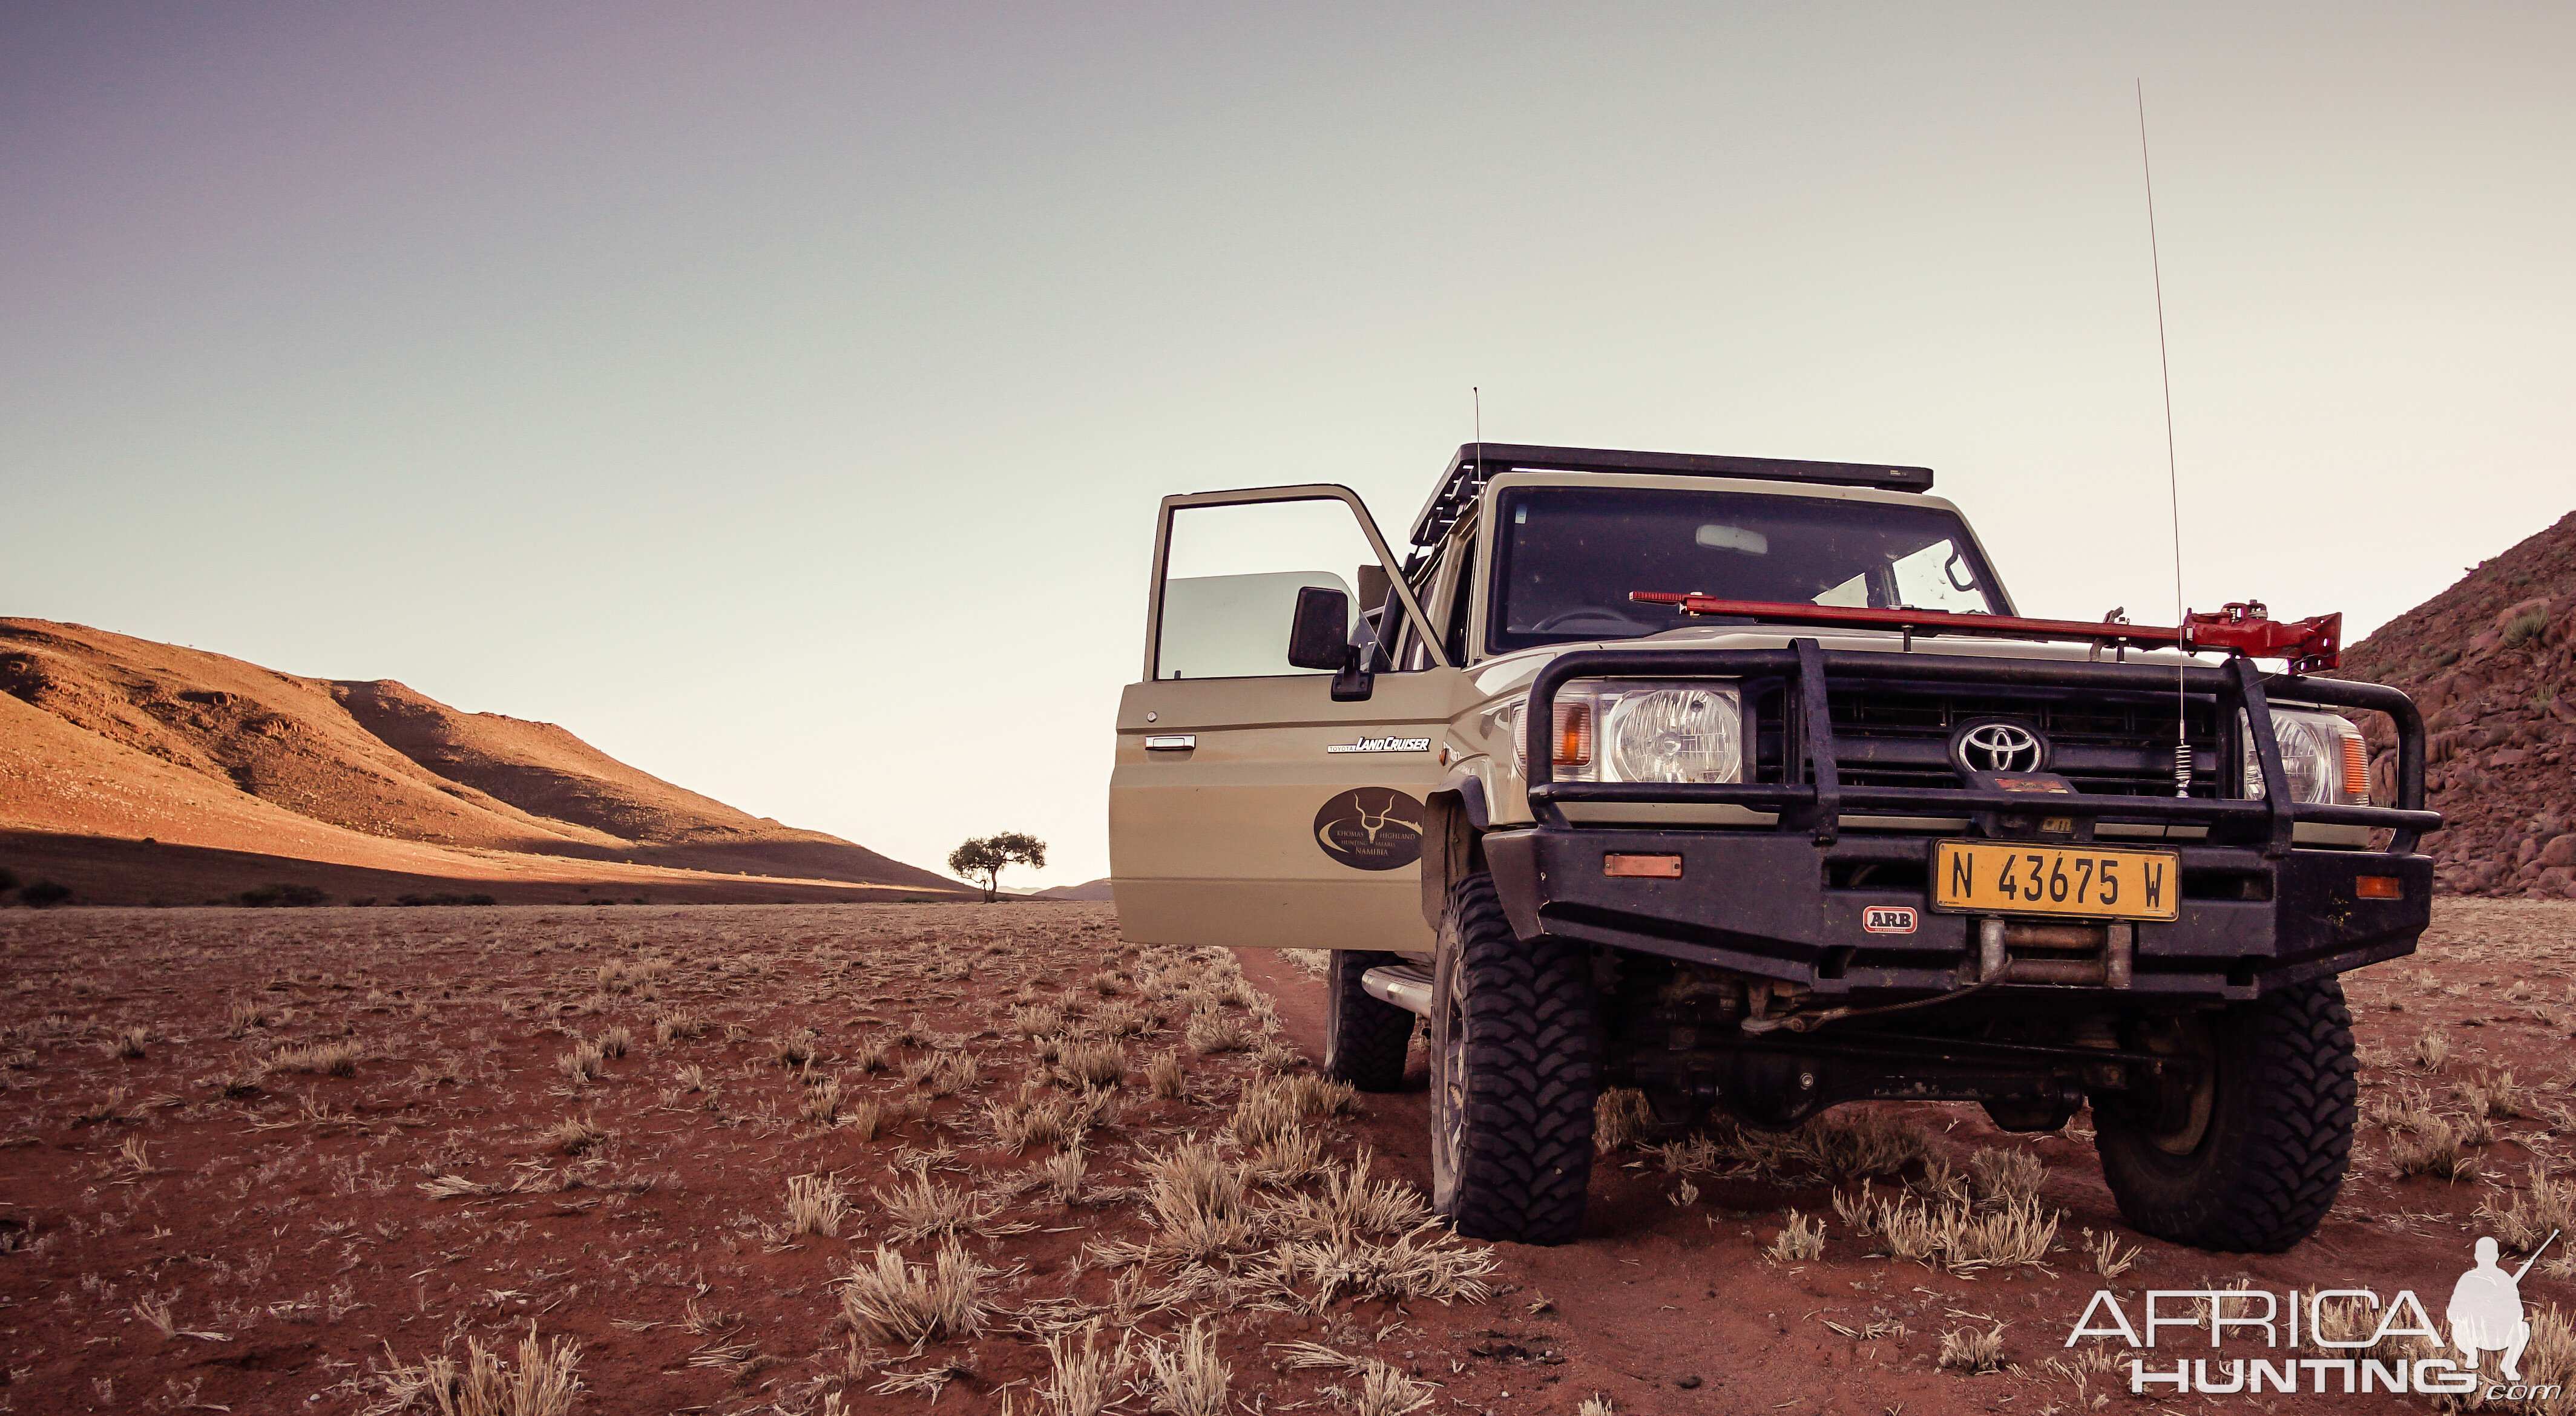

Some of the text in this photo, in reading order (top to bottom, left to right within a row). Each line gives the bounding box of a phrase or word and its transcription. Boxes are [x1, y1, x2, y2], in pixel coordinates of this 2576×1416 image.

[1355, 847, 1388, 856] NAMIBIA
[1952, 852, 2163, 908] N 43675 W
[1870, 912, 1911, 928] ARB
